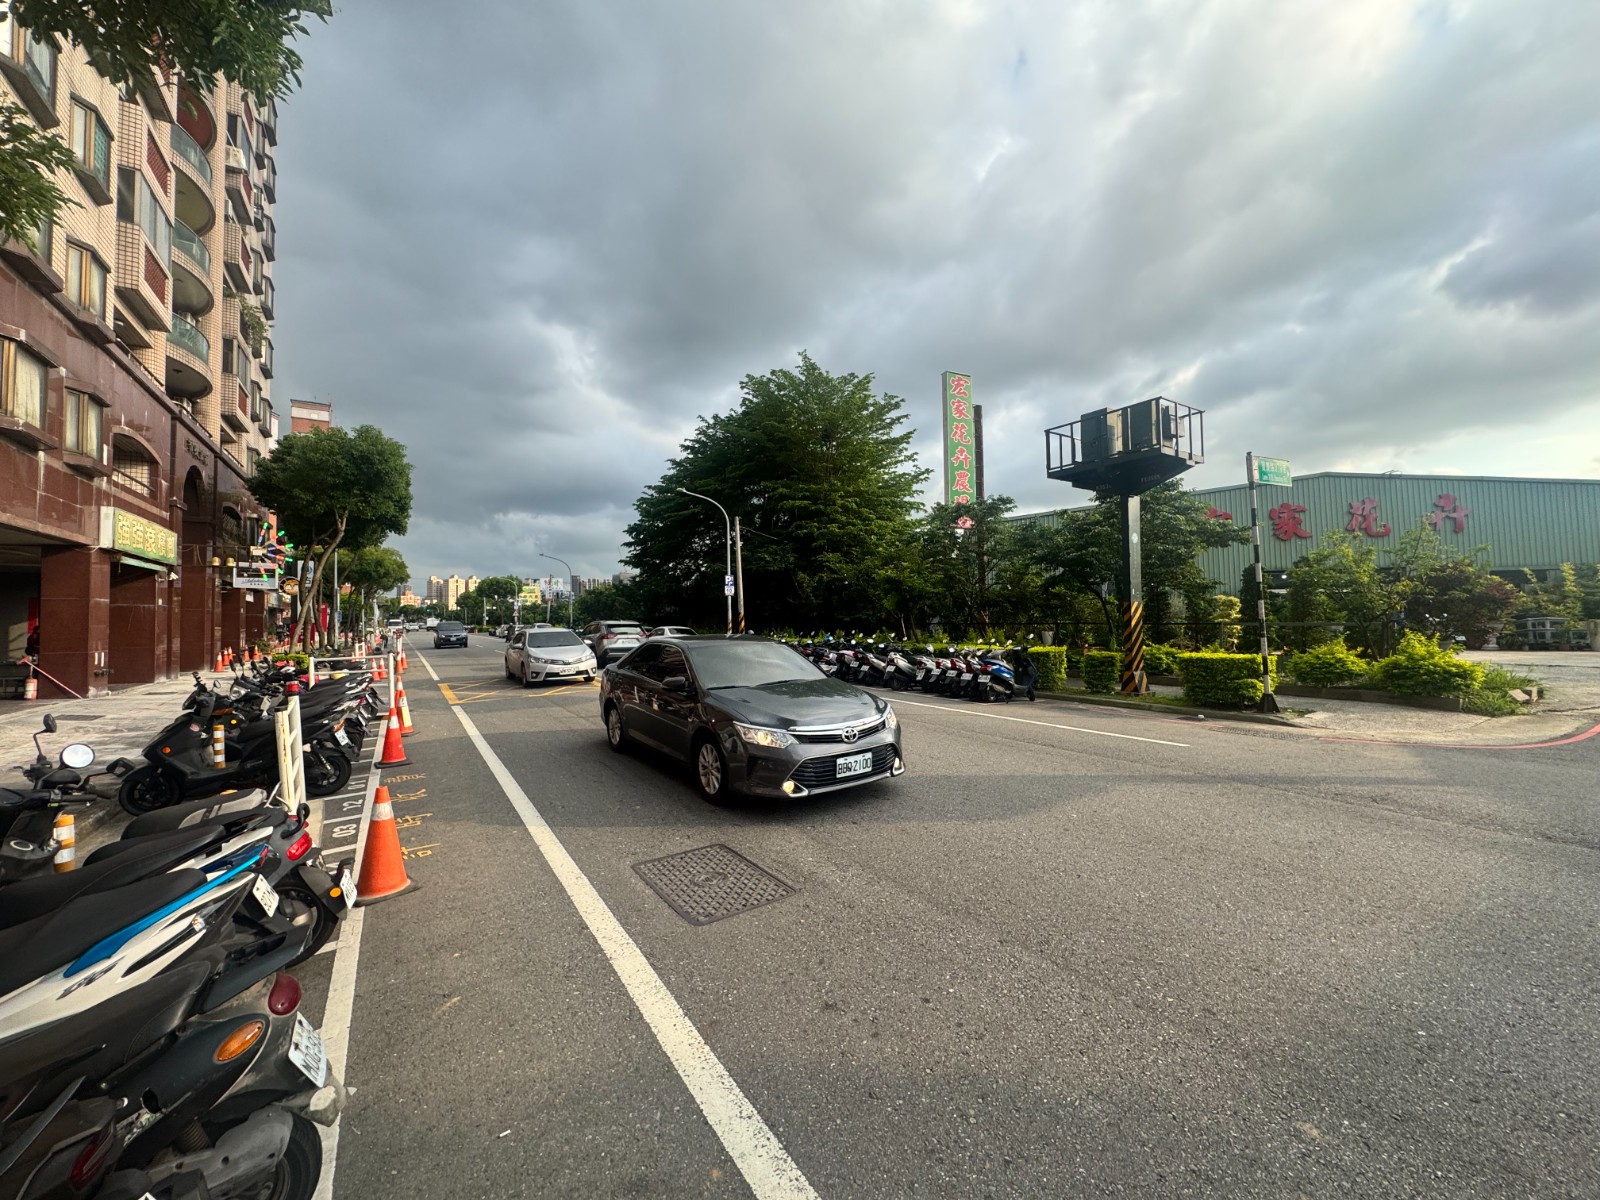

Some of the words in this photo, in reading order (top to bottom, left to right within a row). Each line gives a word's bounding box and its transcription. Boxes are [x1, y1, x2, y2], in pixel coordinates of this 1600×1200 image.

[1207, 493, 1472, 542] 家花卉
[332, 823, 358, 838] 03
